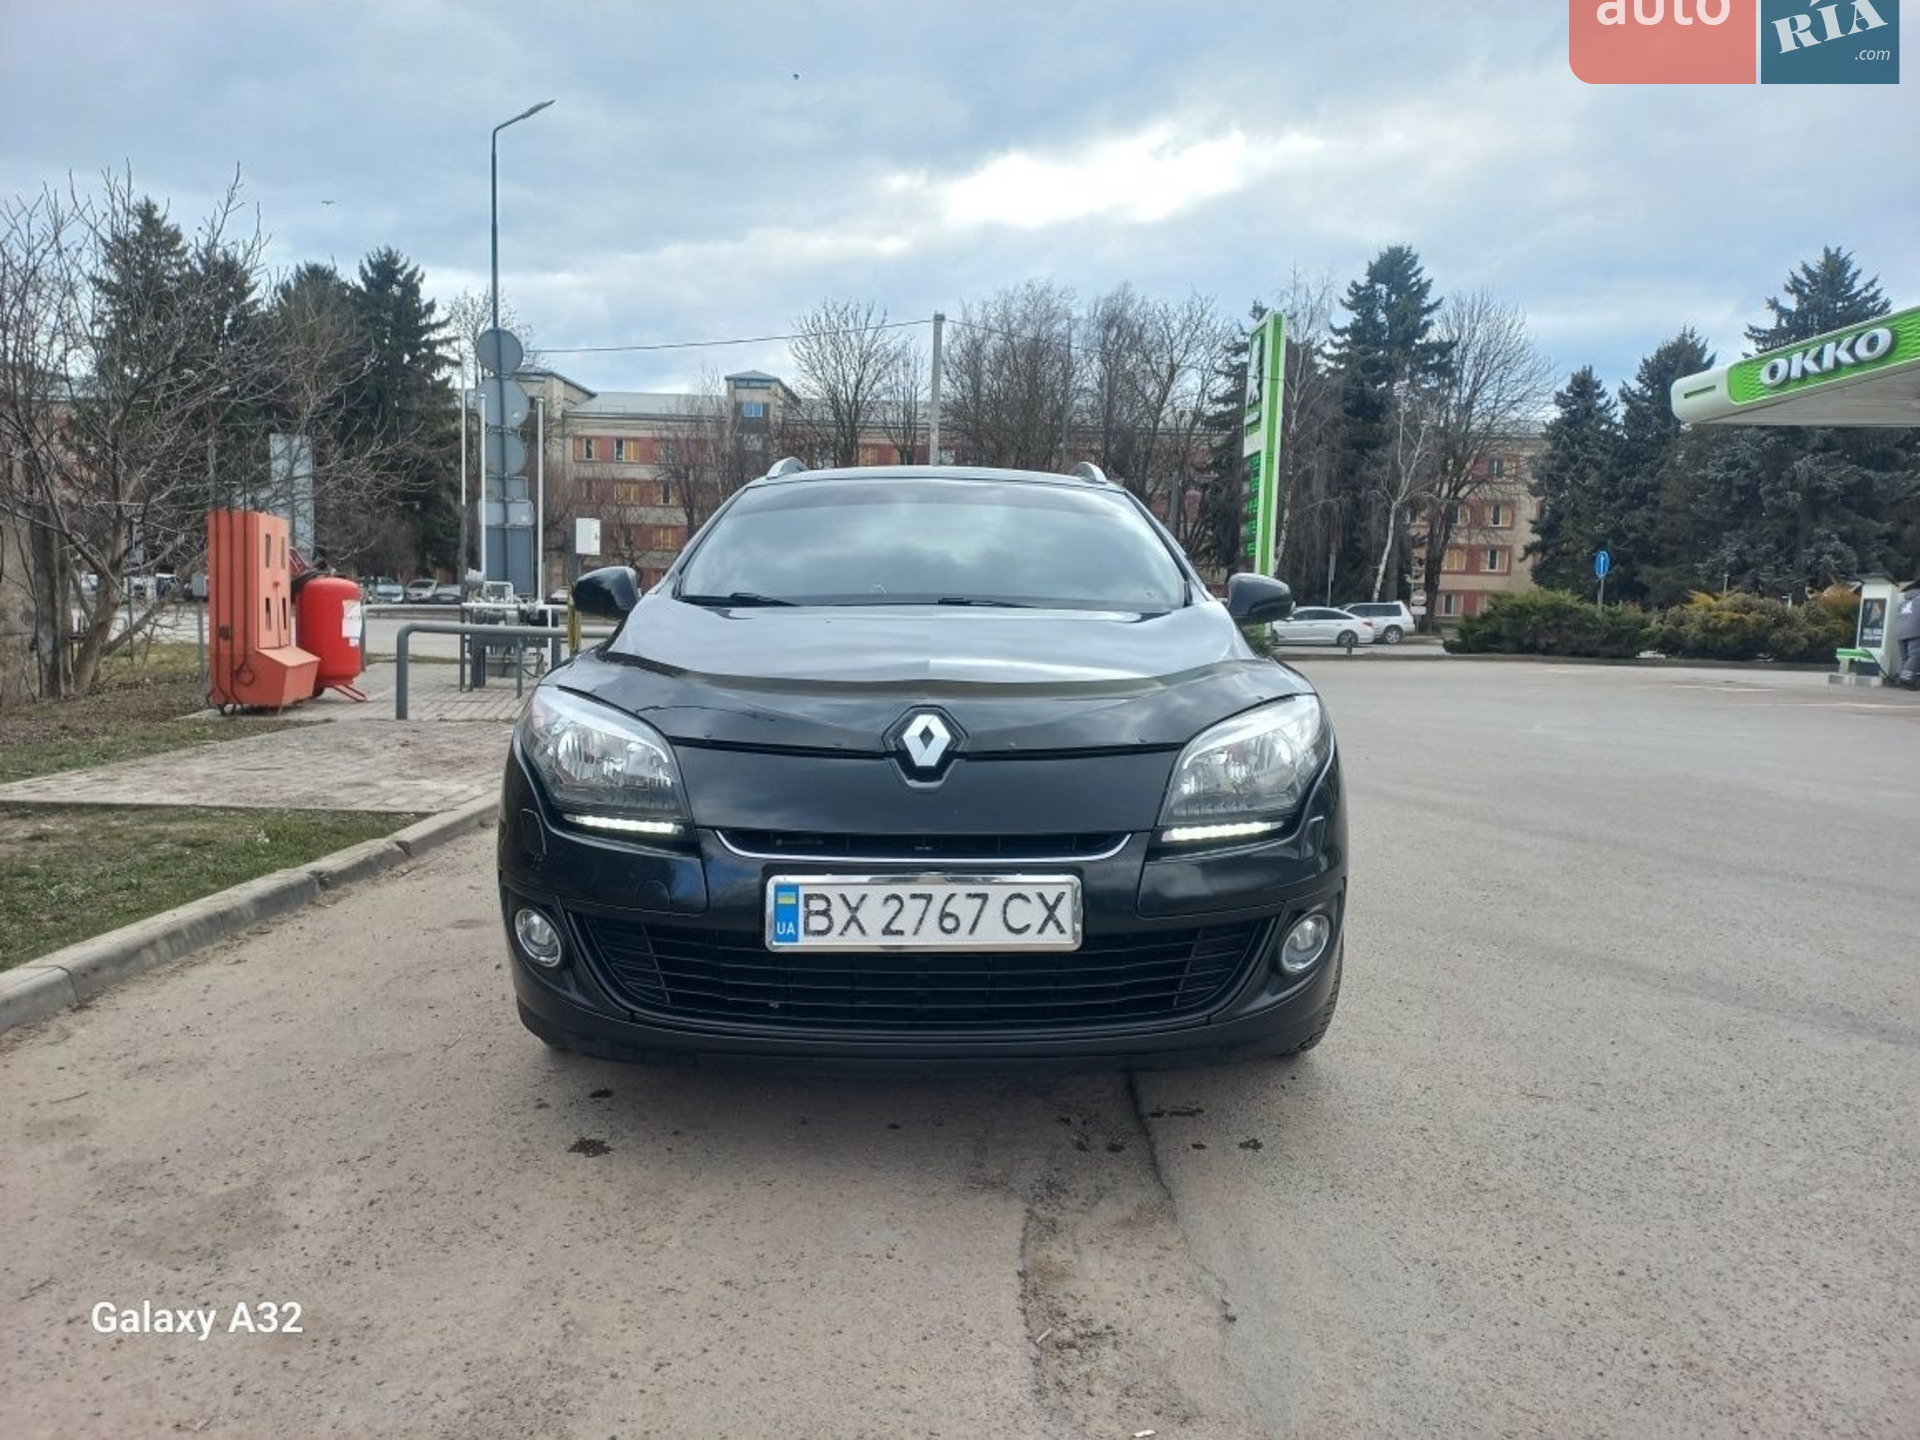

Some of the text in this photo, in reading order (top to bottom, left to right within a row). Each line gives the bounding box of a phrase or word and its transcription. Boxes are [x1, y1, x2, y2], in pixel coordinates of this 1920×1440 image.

[1759, 327, 1892, 387] OKKO
[776, 922, 796, 935] UA
[803, 892, 1067, 936] BX 2767 CX
